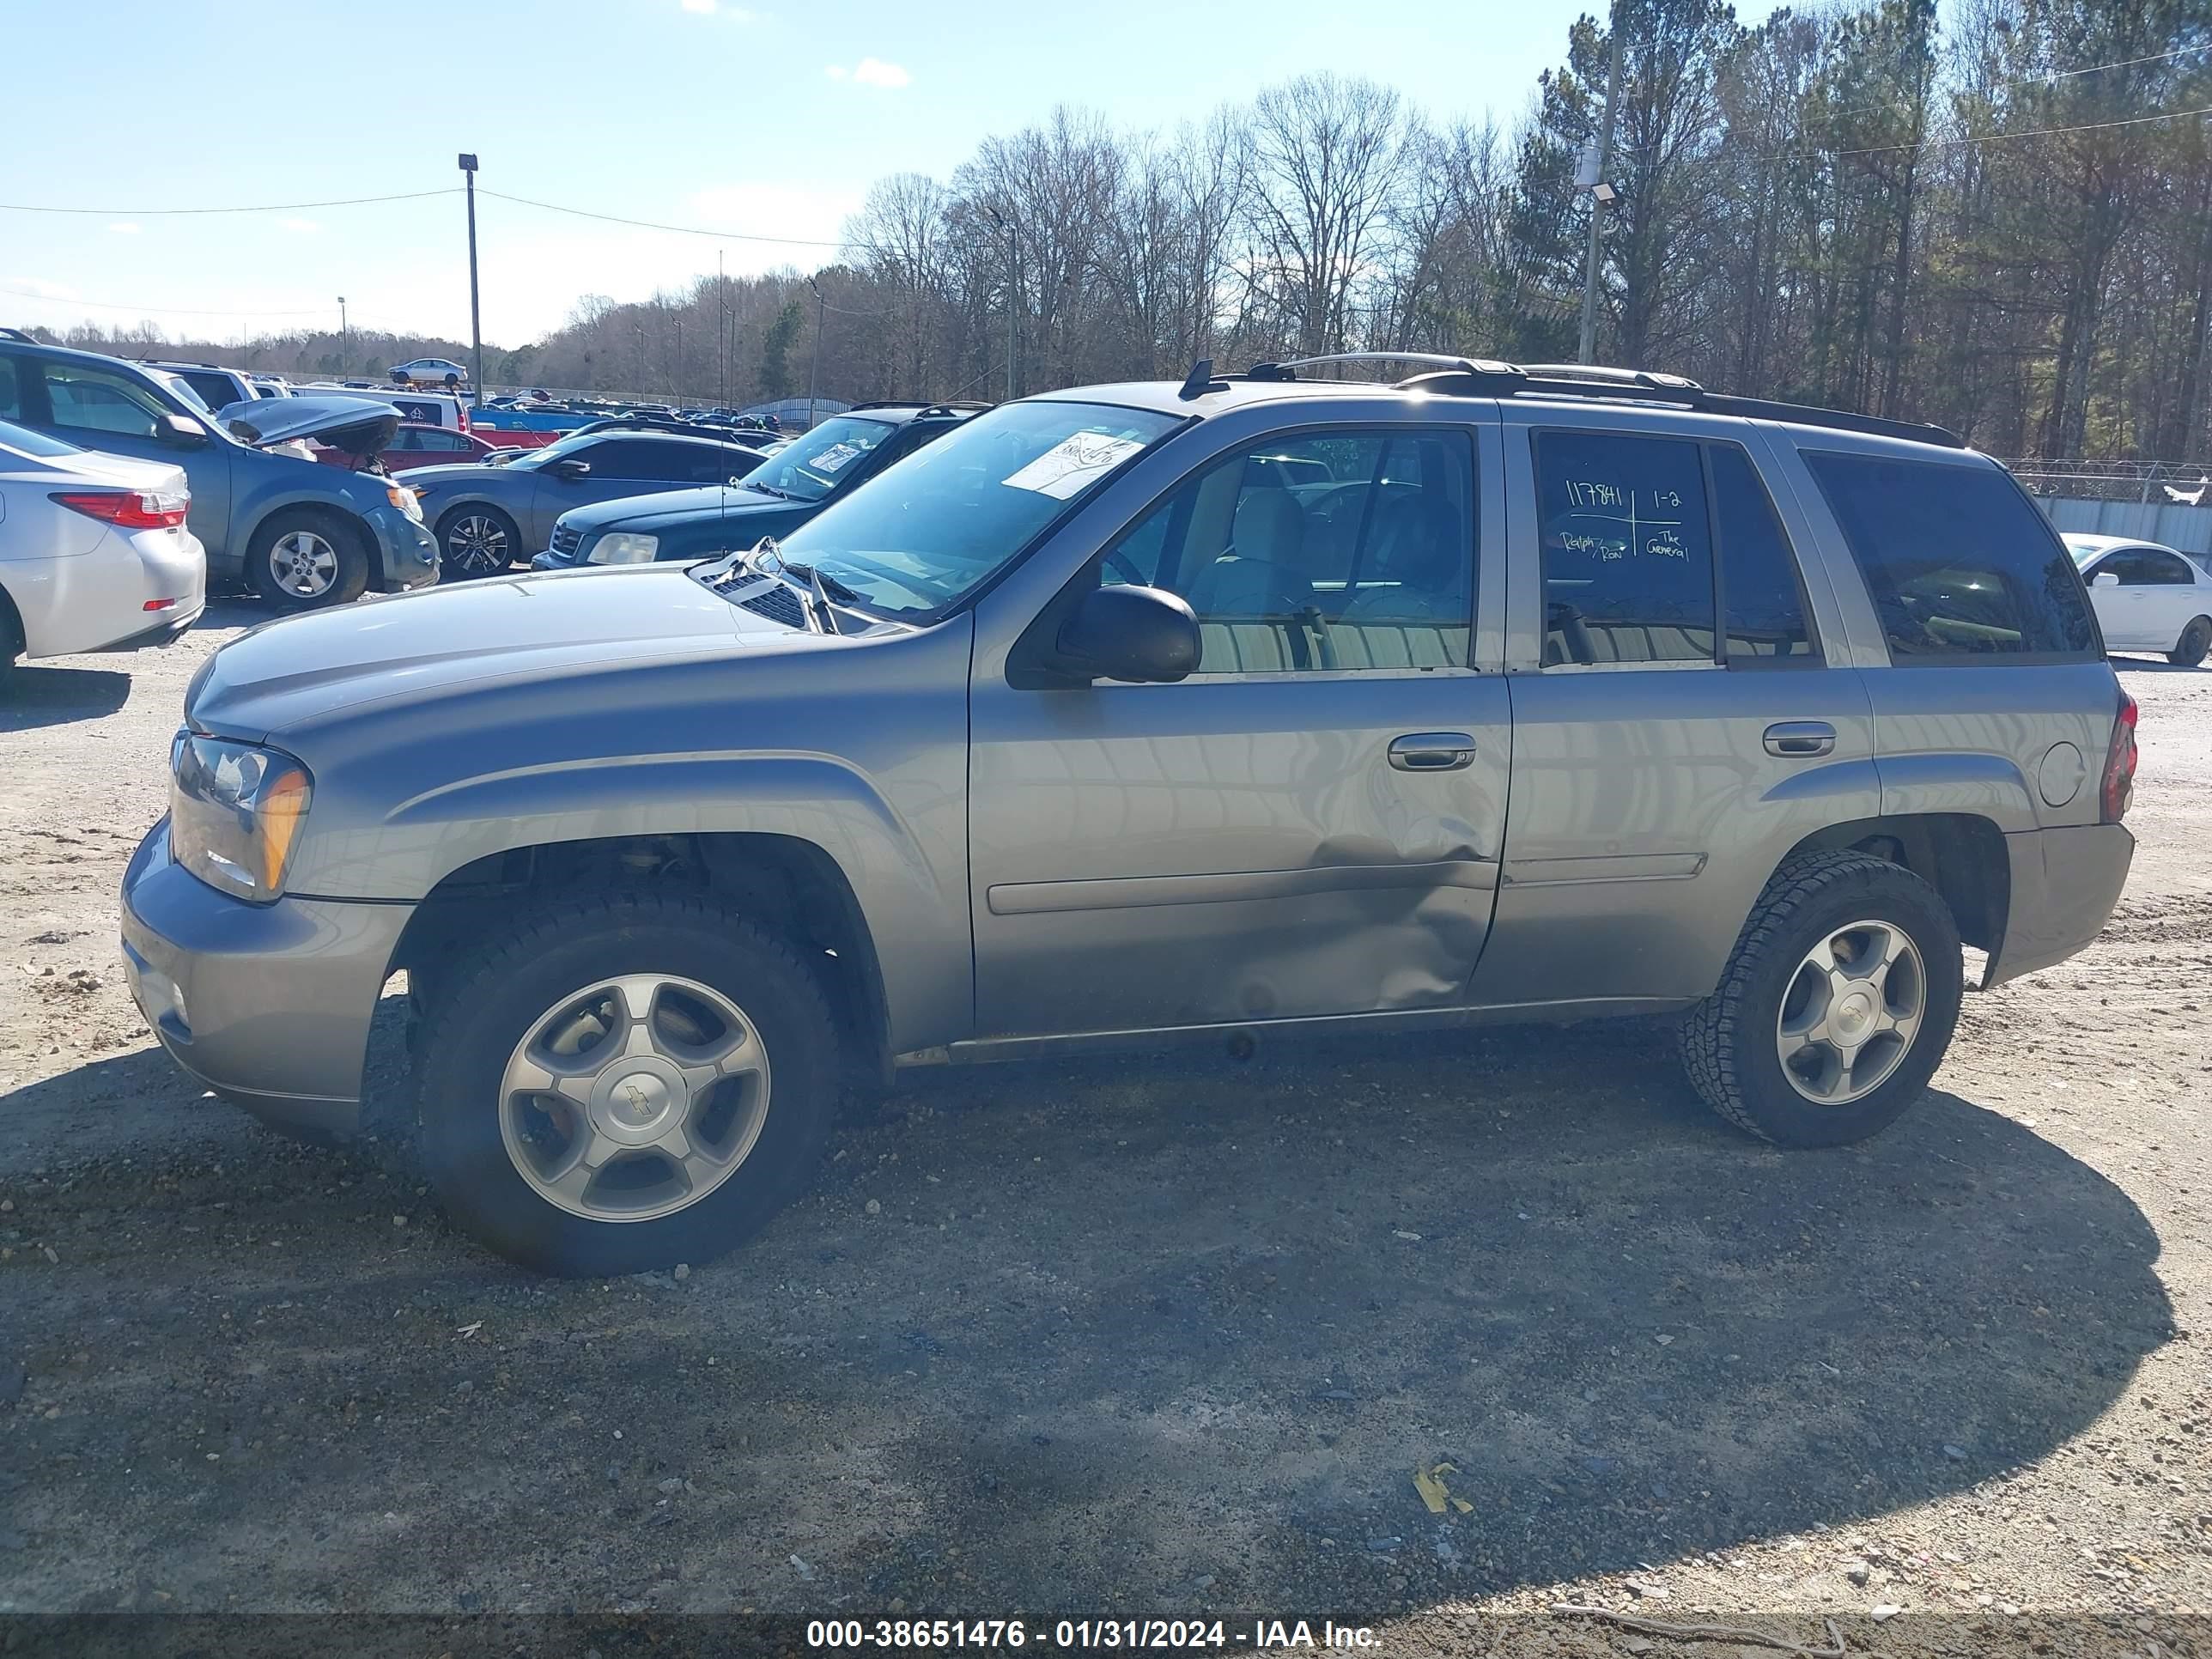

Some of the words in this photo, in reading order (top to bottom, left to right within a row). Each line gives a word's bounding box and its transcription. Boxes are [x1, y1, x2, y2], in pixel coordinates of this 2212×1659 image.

[1565, 479, 1622, 507] 117841
[1654, 490, 1682, 508] 1-2
[1657, 530, 1680, 547] The
[1645, 538, 1690, 562] General
